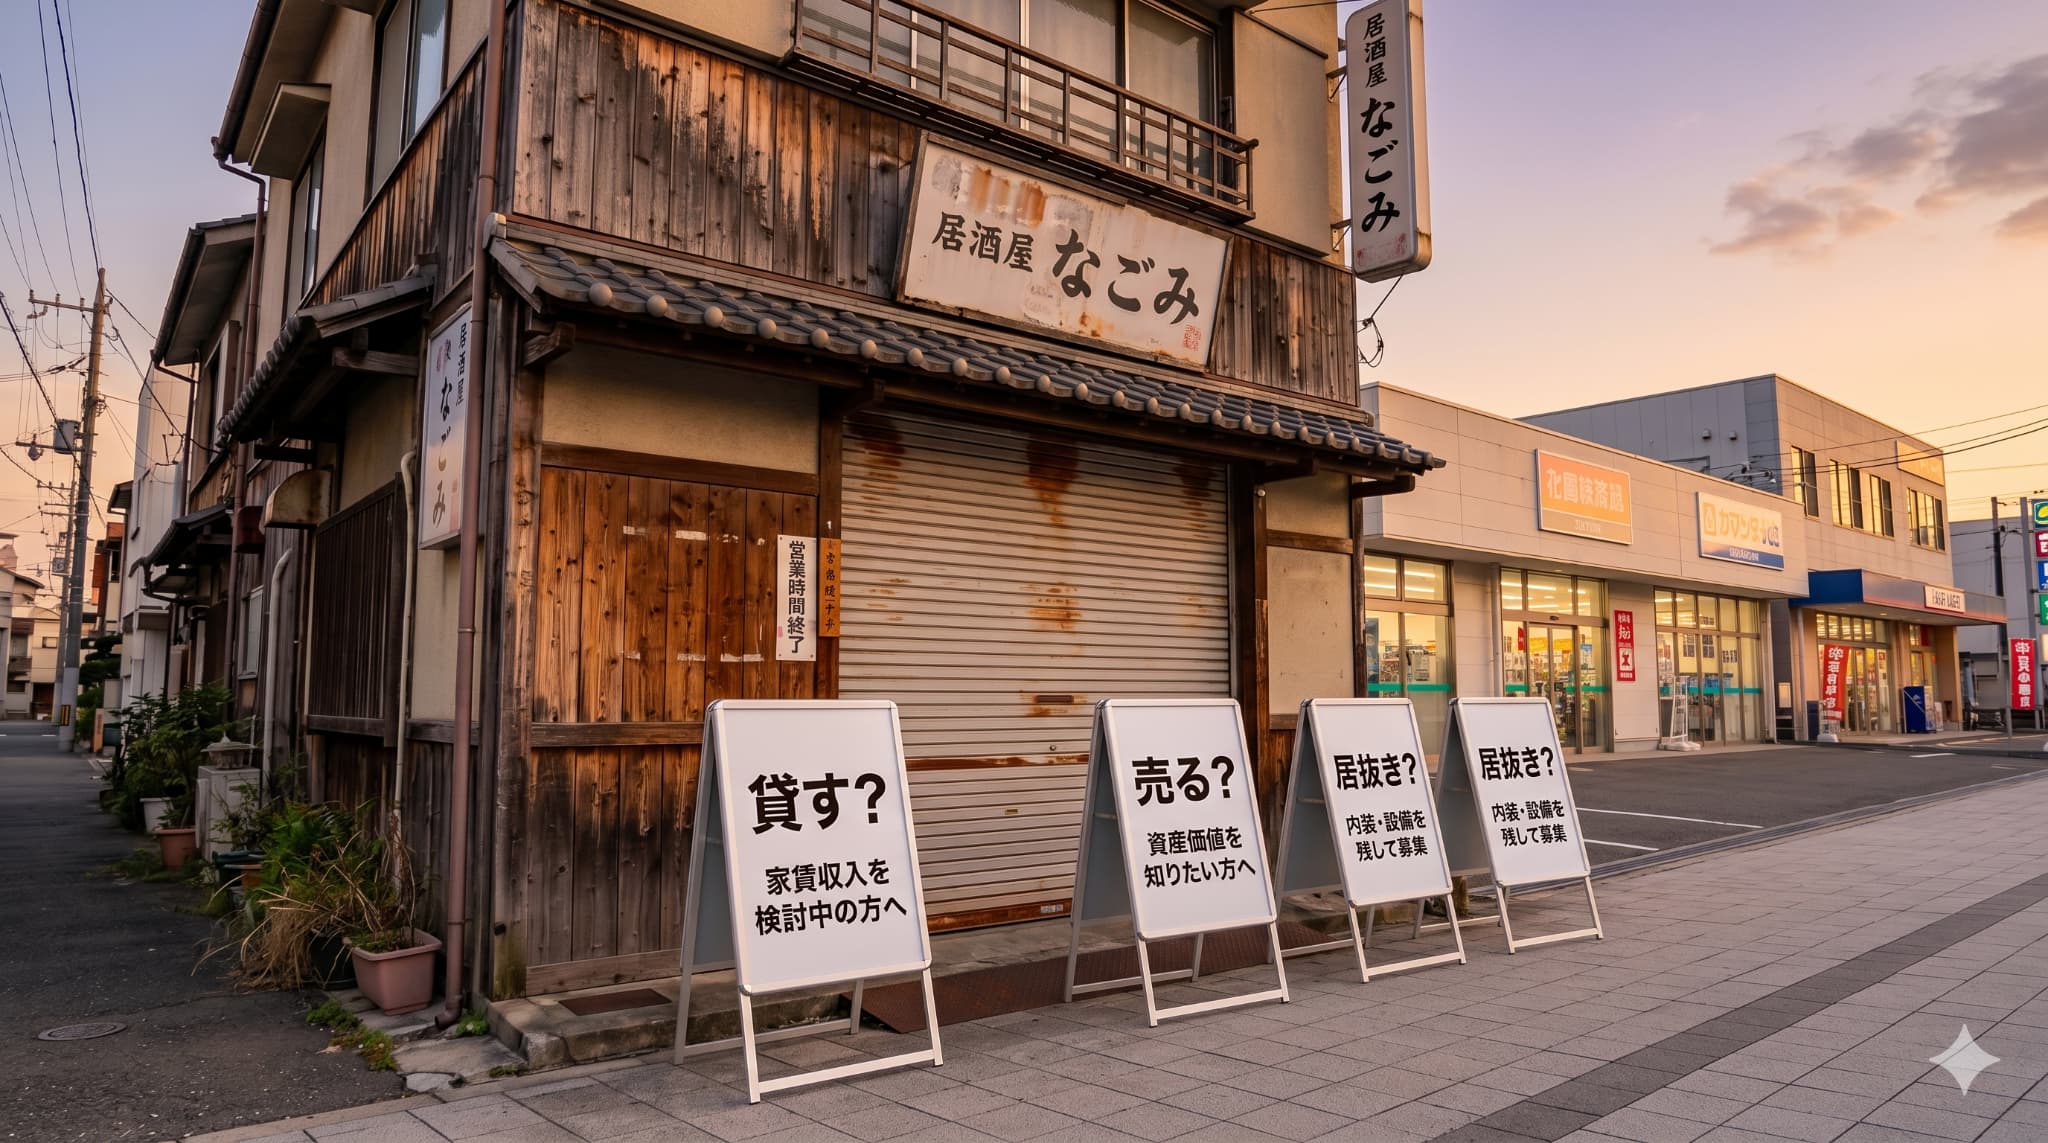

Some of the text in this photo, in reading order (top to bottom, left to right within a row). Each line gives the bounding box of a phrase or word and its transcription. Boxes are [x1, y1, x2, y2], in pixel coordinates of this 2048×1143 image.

[1362, 12, 1388, 89] 居酒屋
[1360, 97, 1401, 233] なごみ
[931, 211, 1200, 326] 居酒屋 なごみ
[787, 540, 807, 654] 営業時間終了
[1131, 755, 1236, 807] 売る?
[1333, 752, 1418, 791] 居抜き?
[1478, 745, 1555, 781] 居抜き?
[747, 772, 887, 836] 貸す?
[1345, 809, 1427, 837] 内装・設備を
[1491, 799, 1565, 824] 内装・設備を
[1146, 826, 1243, 857] 資産価値を
[1355, 835, 1429, 862] 残して募集
[1500, 823, 1568, 848] 残して募集
[765, 858, 890, 896] 家賃収入を
[1143, 857, 1257, 889] 知りたい方へ
[754, 894, 908, 936] 検討中の方へ
